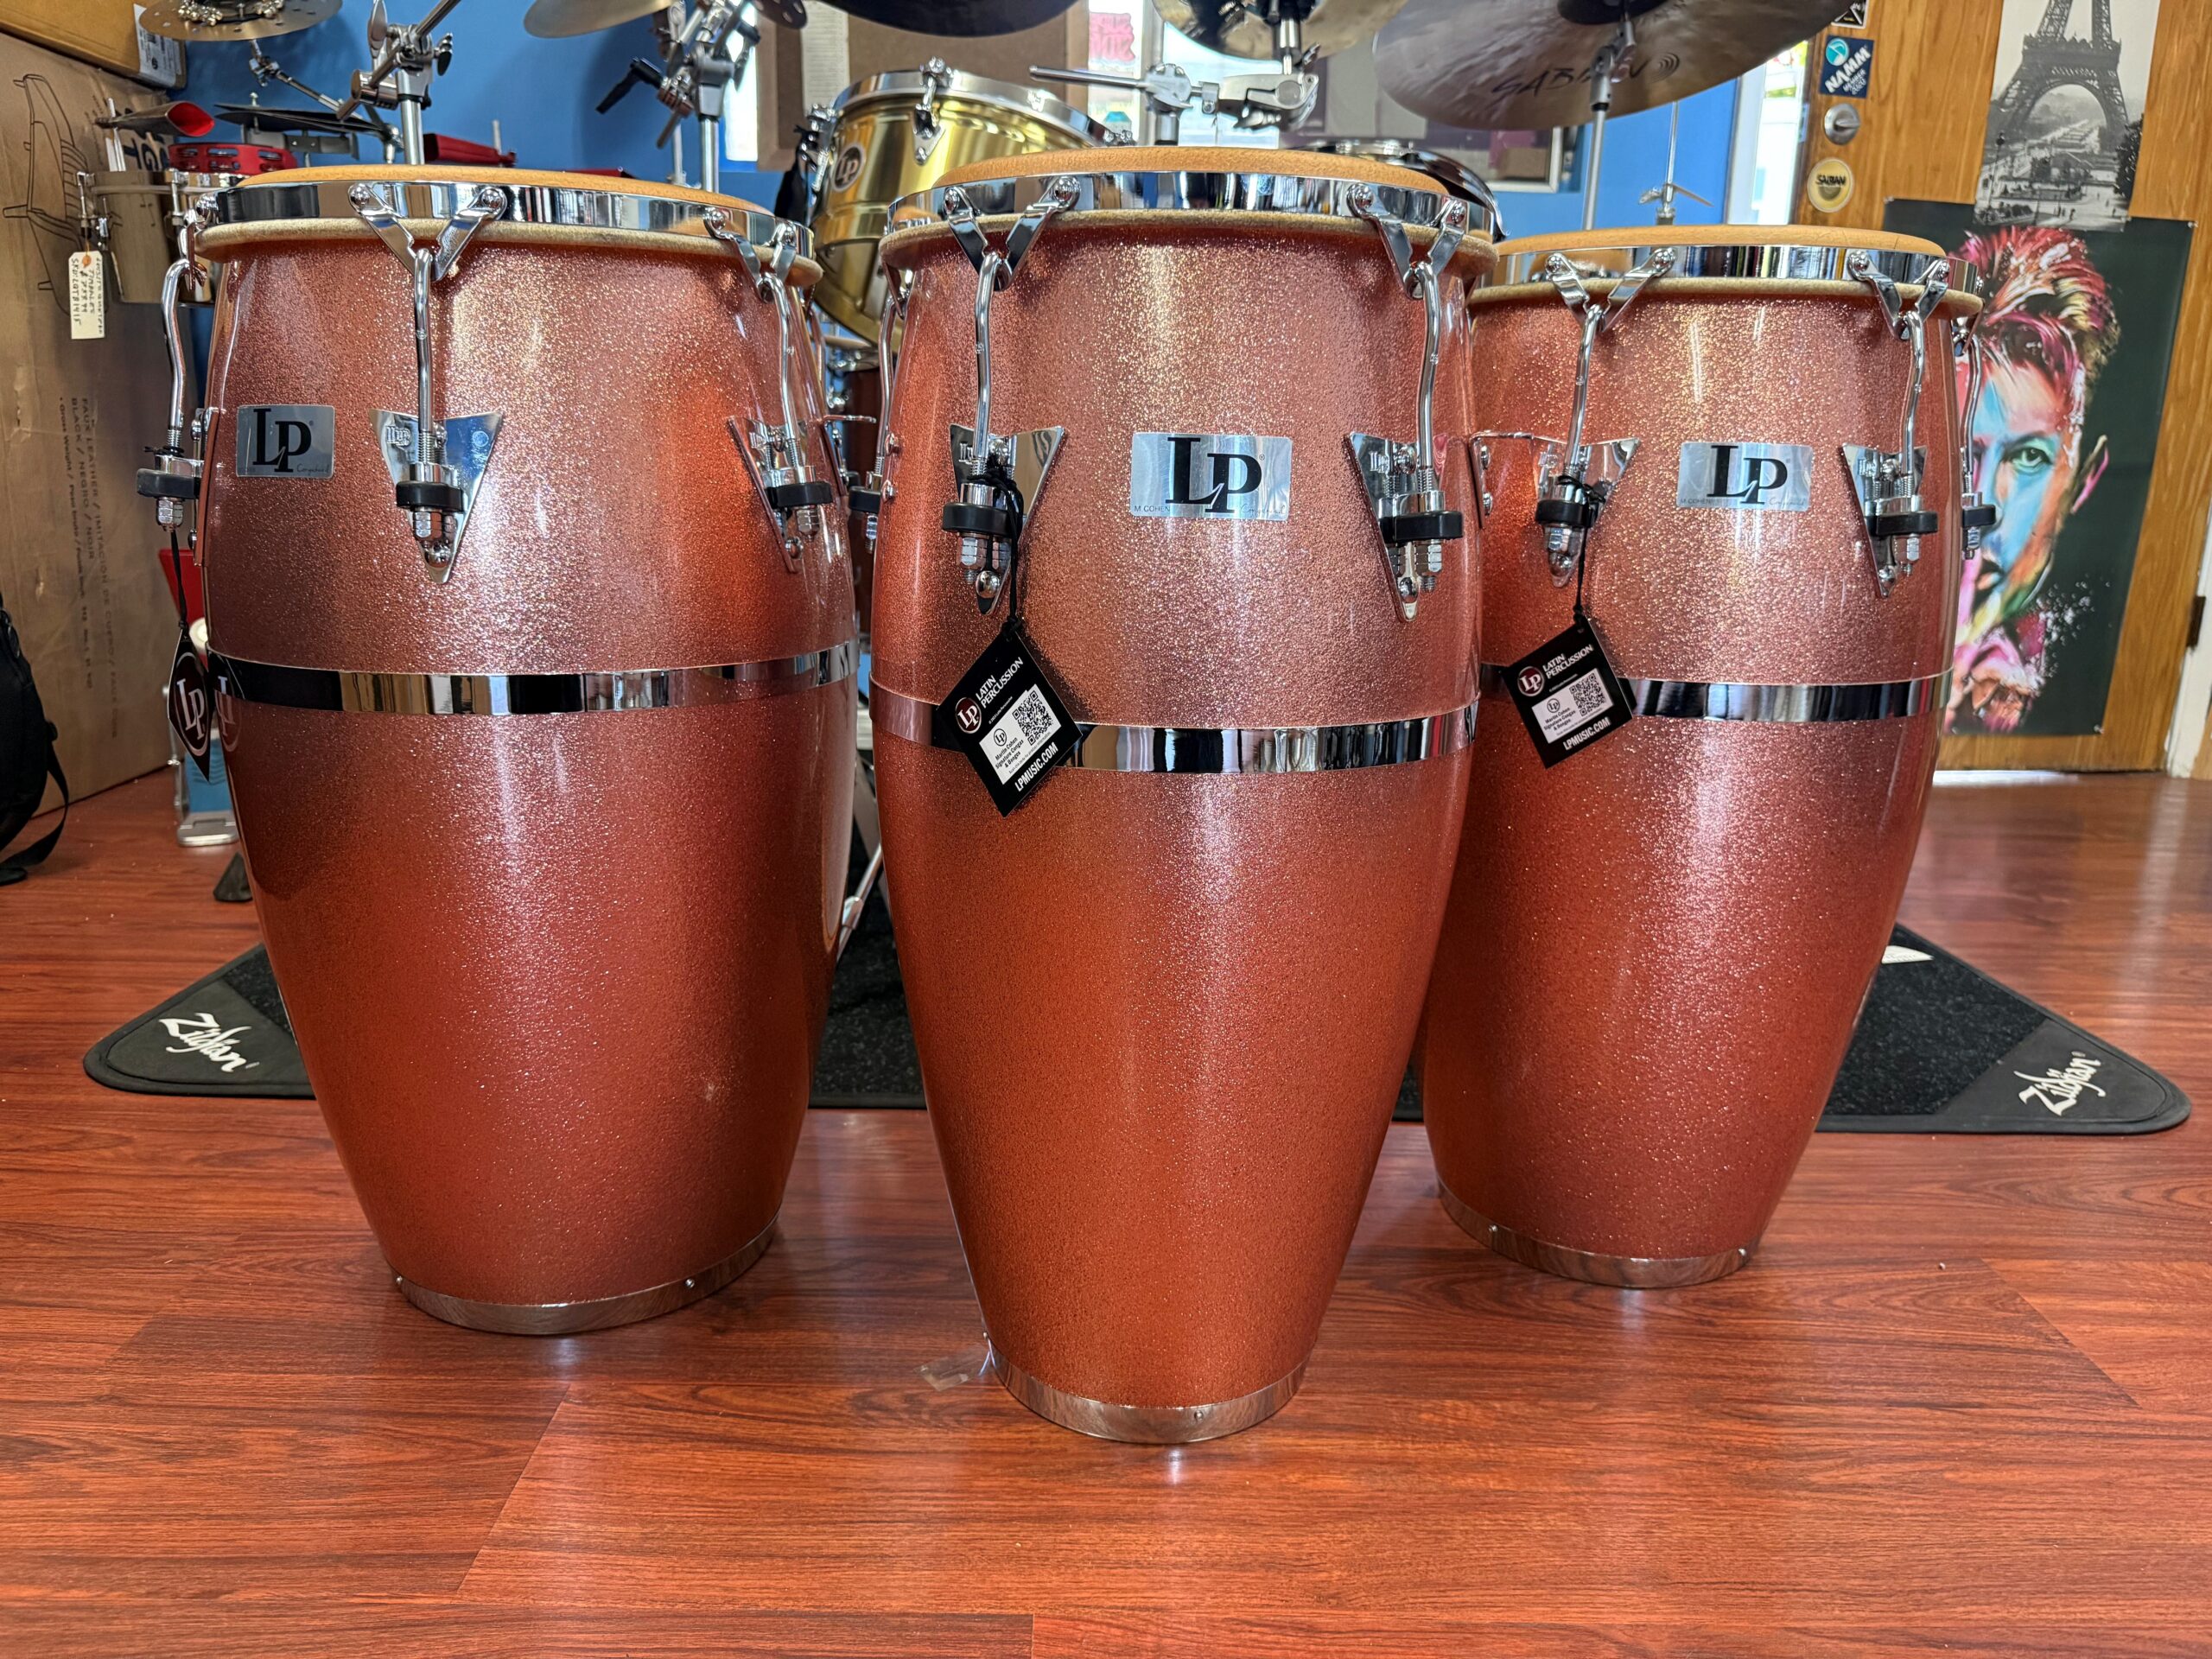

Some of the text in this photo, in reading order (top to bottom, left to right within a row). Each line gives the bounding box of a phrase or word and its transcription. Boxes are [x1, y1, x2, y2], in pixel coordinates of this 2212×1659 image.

[1825, 47, 1871, 92] NAMM
[837, 156, 859, 183] LP
[71, 397, 81, 442] BLACK
[79, 461, 89, 507] NEGRO
[252, 408, 311, 473] LP
[86, 437, 97, 497] LEATHER
[1165, 437, 1262, 513] LP
[1707, 445, 1788, 505] LP
[980, 657, 1024, 709] PERCUSSION
[1520, 674, 1541, 692] LP
[1542, 653, 1567, 672] LATIN
[1546, 644, 1594, 680] PERCUSSION
[177, 678, 205, 740] LP
[976, 675, 996, 701] LATIN
[957, 704, 979, 729] LP
[995, 732, 1006, 744] LP
[1562, 716, 1611, 751] LPMUSIC.COM
[995, 737, 1018, 760] Martin Cohen
[995, 739, 1024, 769] Signature Congas
[1014, 741, 1059, 792] LPMUSIC.COM
[159, 1012, 252, 1073] Zildjian
[2013, 1052, 2107, 1116] Zildjian
